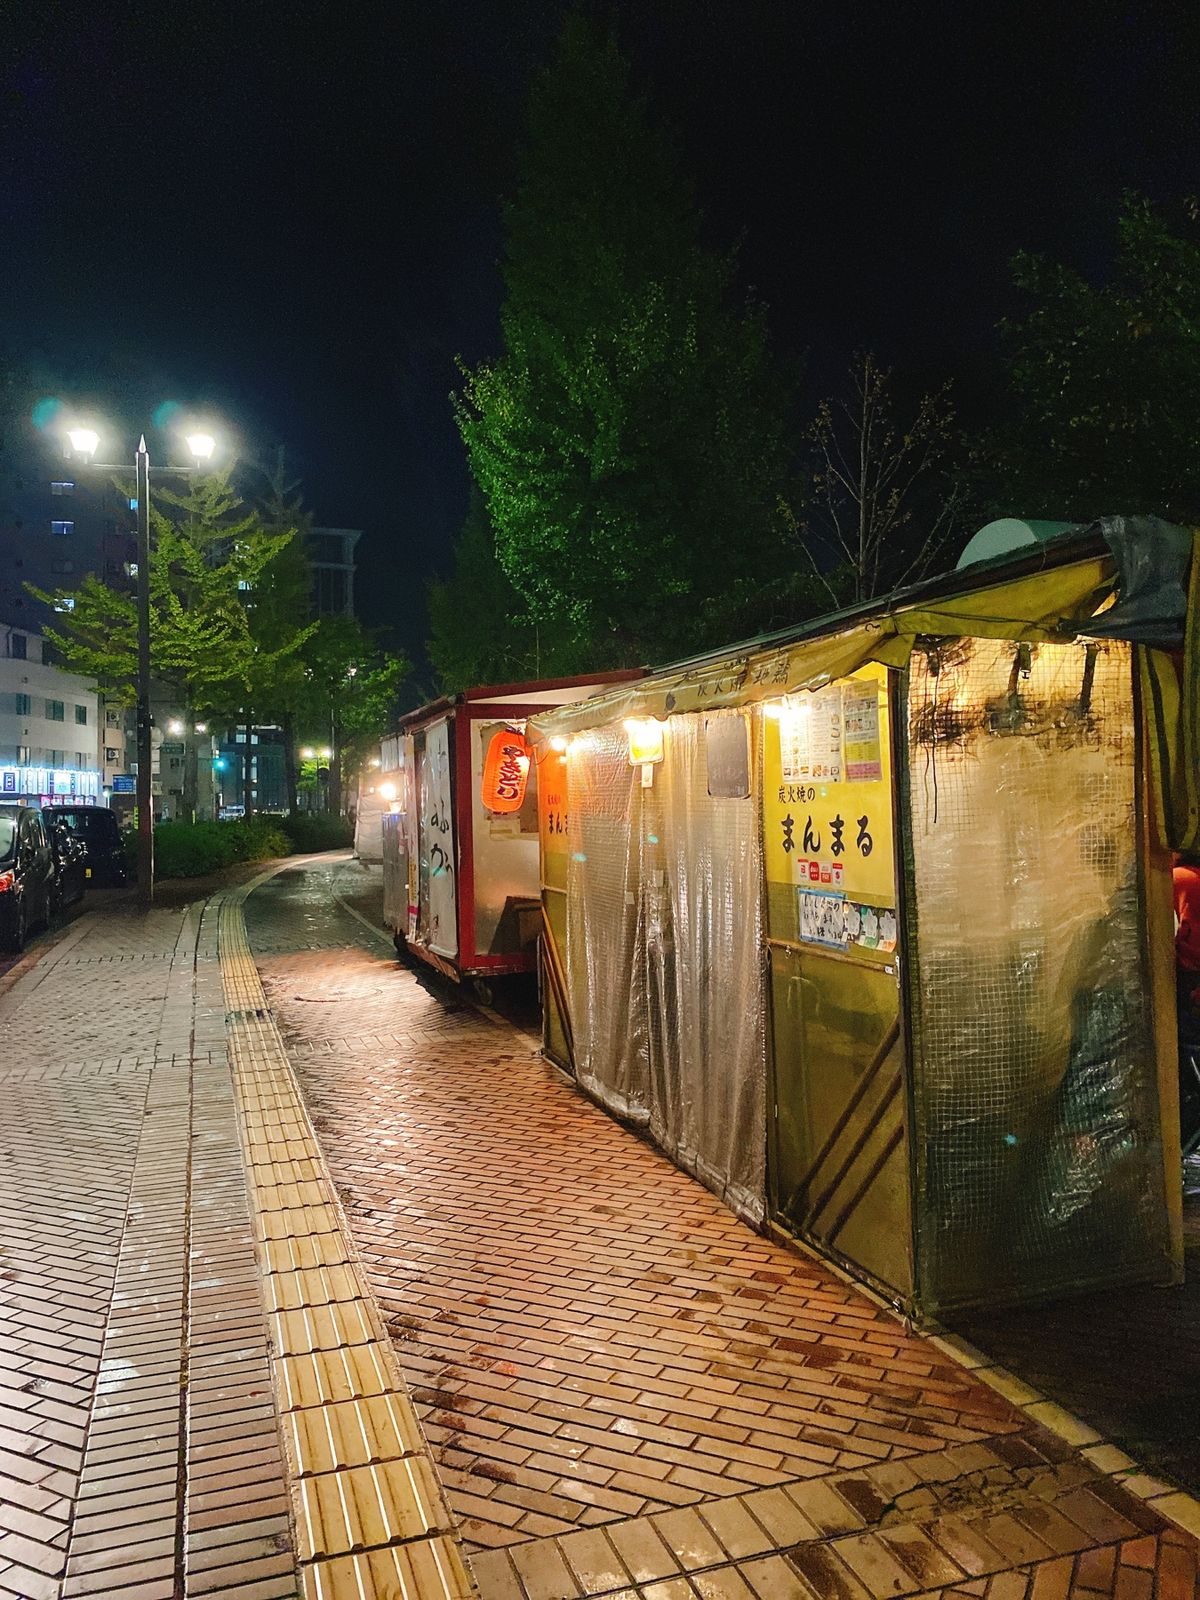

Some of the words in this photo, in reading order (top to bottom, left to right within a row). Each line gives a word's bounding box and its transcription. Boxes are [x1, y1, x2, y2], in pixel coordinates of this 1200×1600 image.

[778, 785, 815, 803] 炭火焼の
[780, 813, 873, 857] まんまる
